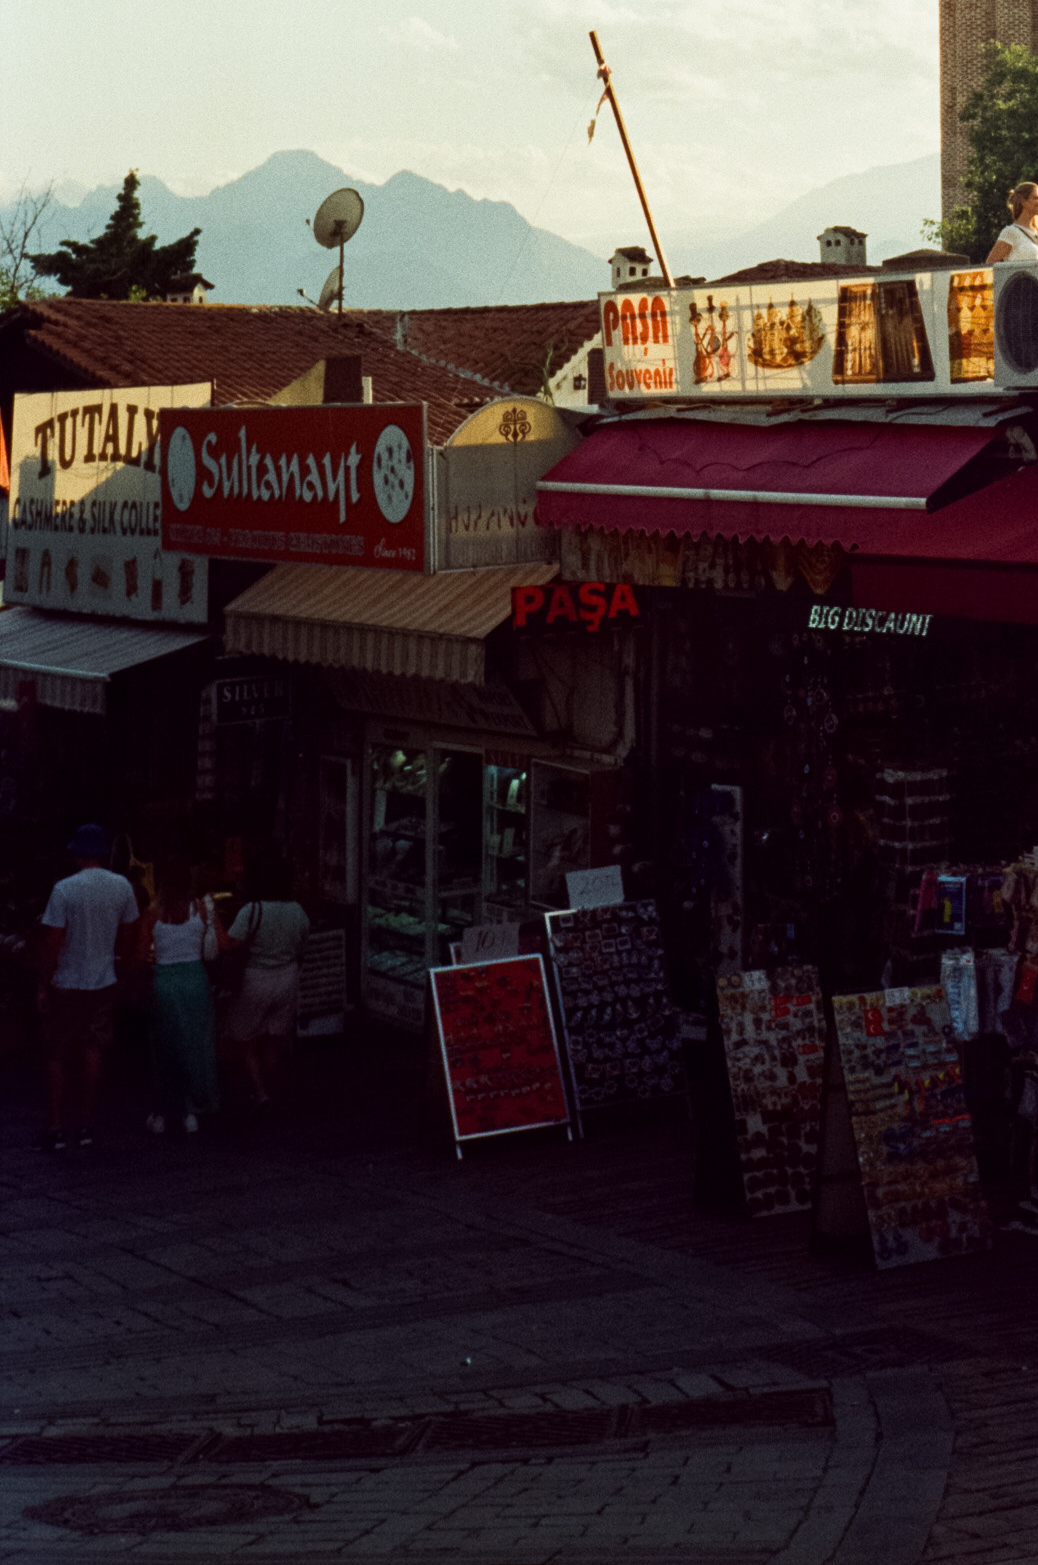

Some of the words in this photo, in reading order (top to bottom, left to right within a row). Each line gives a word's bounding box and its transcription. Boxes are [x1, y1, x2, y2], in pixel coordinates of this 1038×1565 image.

[603, 295, 669, 356] PAŞA
[608, 360, 675, 393] Souvenir
[34, 402, 161, 480] TUTALY
[201, 424, 363, 524] Sultanayt
[12, 497, 75, 533] CASHMERE
[78, 498, 87, 534] &
[90, 498, 118, 535] SILK
[512, 582, 640, 633] PAŞA
[808, 604, 840, 630] BIG
[842, 608, 934, 637] DISCAUNT
[221, 679, 285, 703] SILVER
